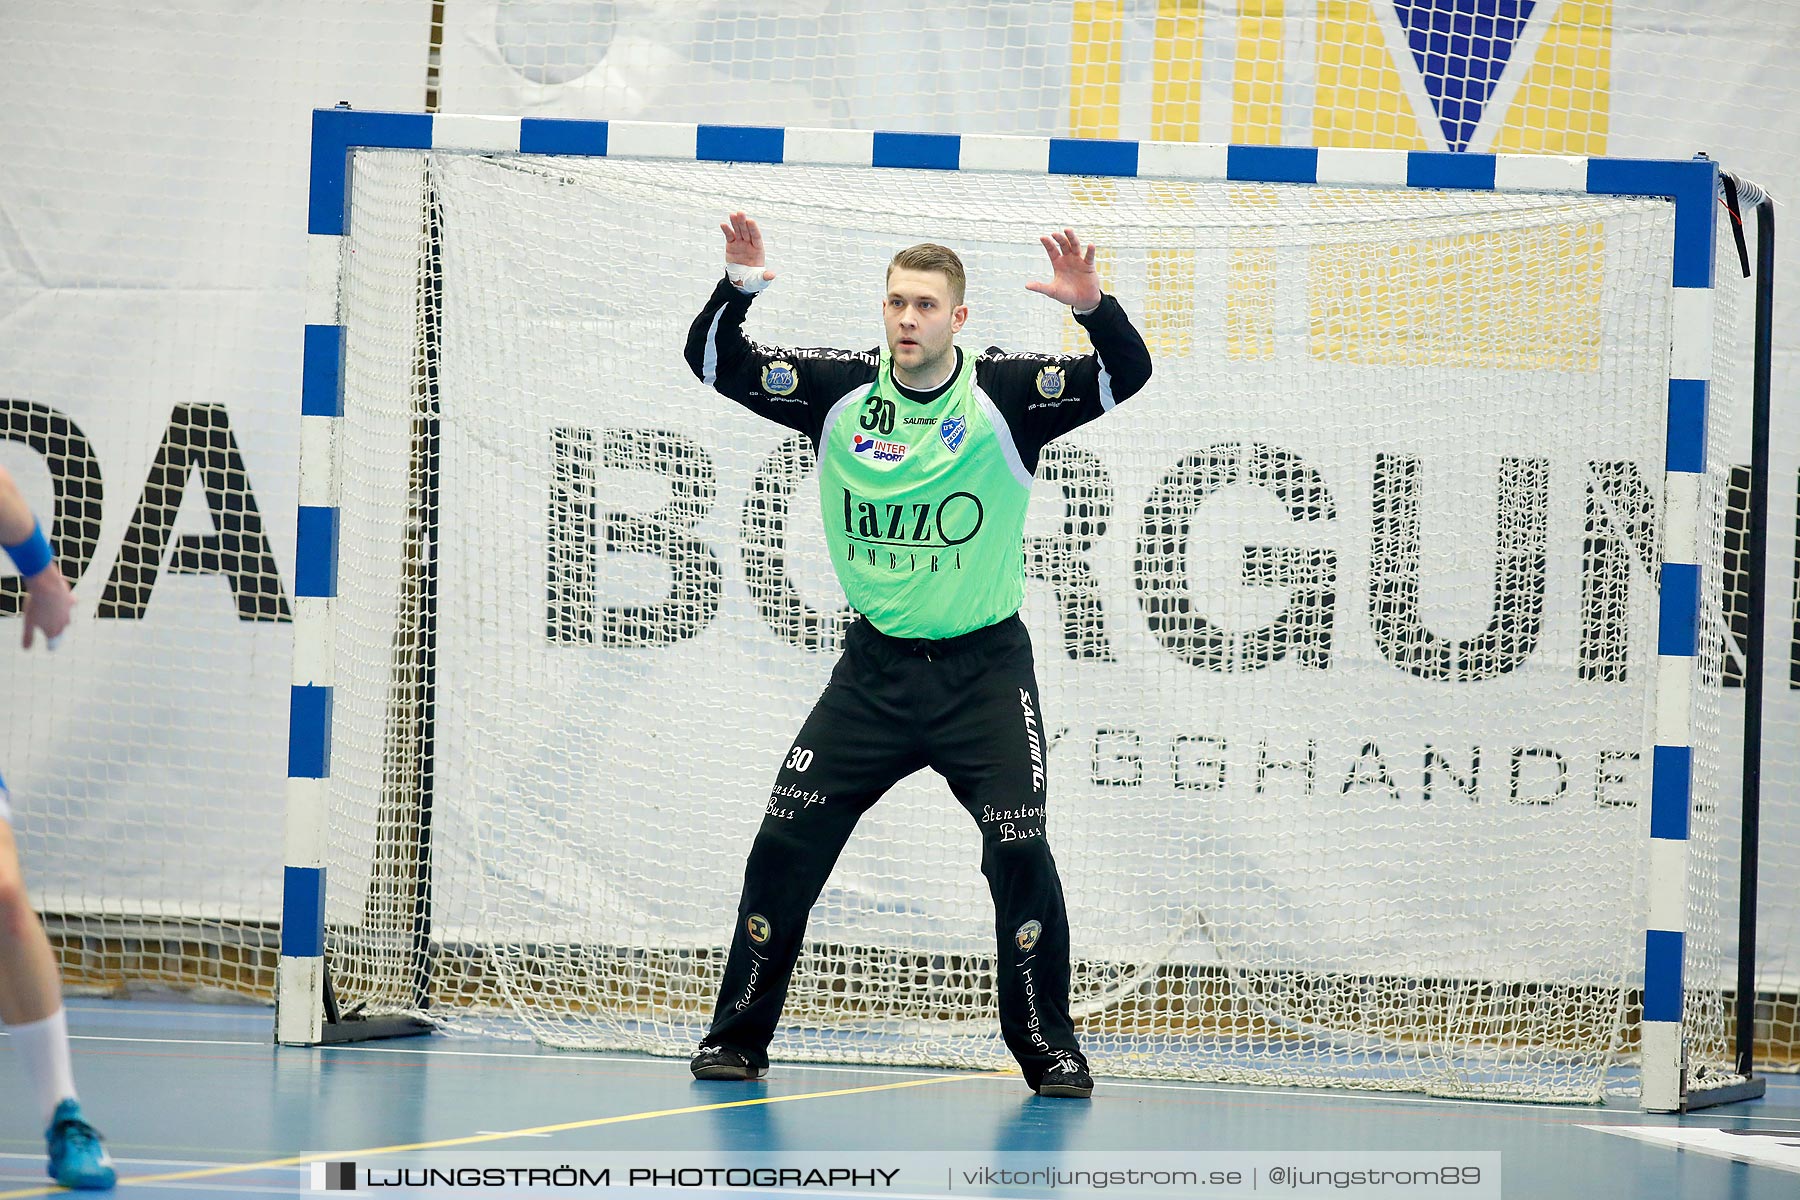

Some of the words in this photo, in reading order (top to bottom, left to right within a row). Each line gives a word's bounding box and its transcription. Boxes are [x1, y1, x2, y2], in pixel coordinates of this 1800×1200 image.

[860, 396, 896, 435] 30
[873, 450, 904, 462] SPORT
[874, 441, 906, 454] INTER
[785, 746, 814, 773] 30
[765, 796, 795, 819] Buss
[1000, 822, 1041, 842] Buss
